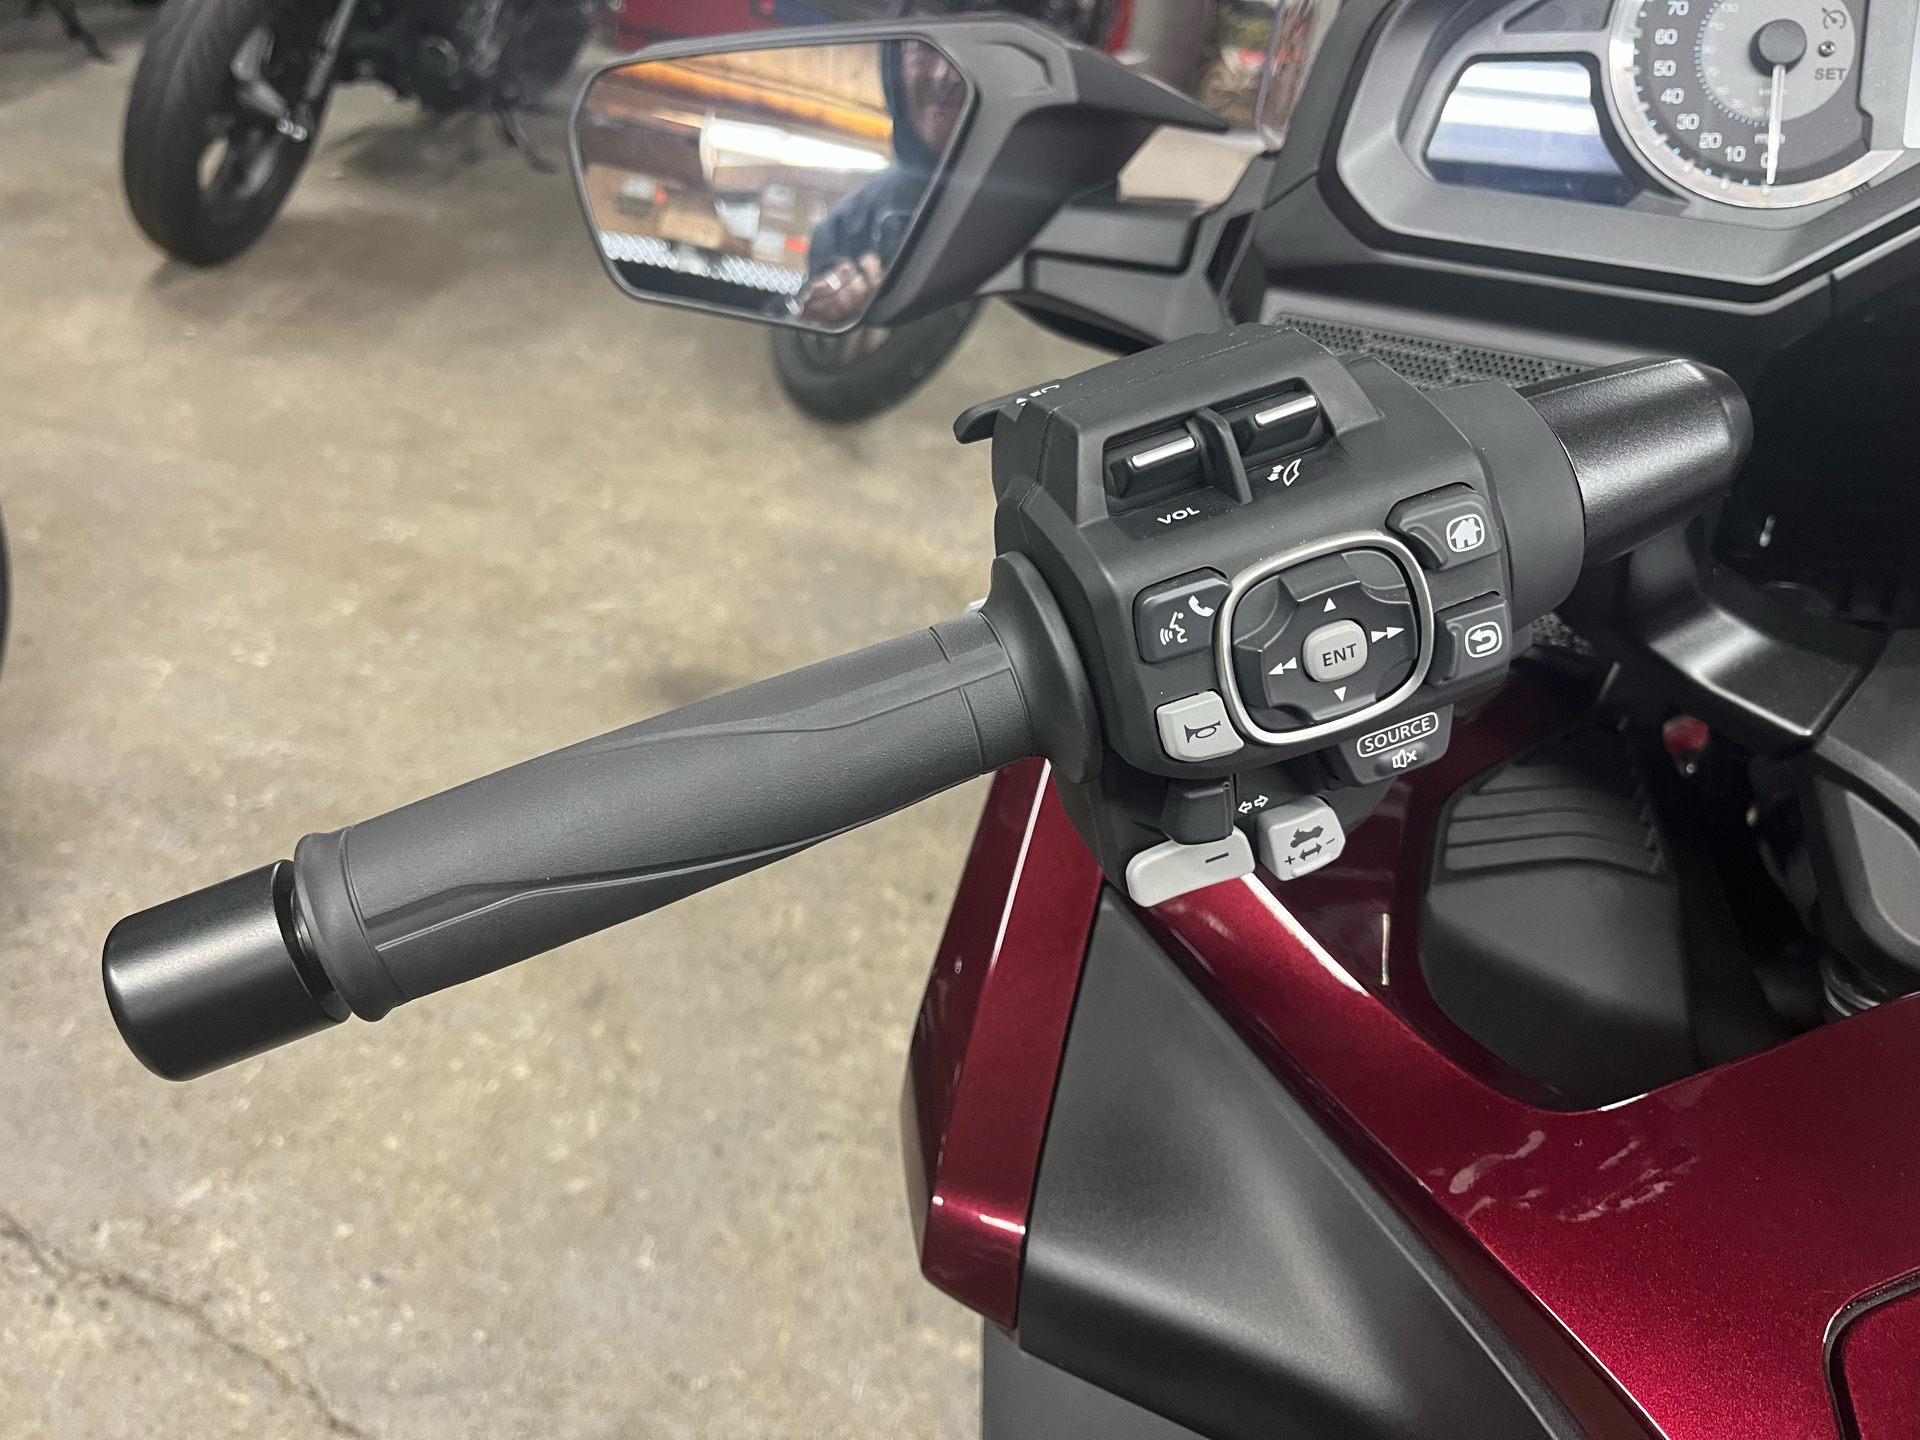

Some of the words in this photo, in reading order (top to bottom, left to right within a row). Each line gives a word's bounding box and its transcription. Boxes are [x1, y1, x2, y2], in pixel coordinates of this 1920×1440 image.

[1667, 0, 1689, 15] 70
[1655, 29, 1678, 45] 60
[1653, 60, 1676, 76] 50
[1814, 68, 1847, 81] SET
[1660, 88, 1684, 104] 40
[1676, 113, 1700, 130] 30
[1699, 132, 1722, 148] 20
[1725, 145, 1746, 162] 10
[1157, 507, 1200, 524] VOL
[1322, 643, 1357, 667] ENT
[1364, 717, 1431, 752] SOURCE
